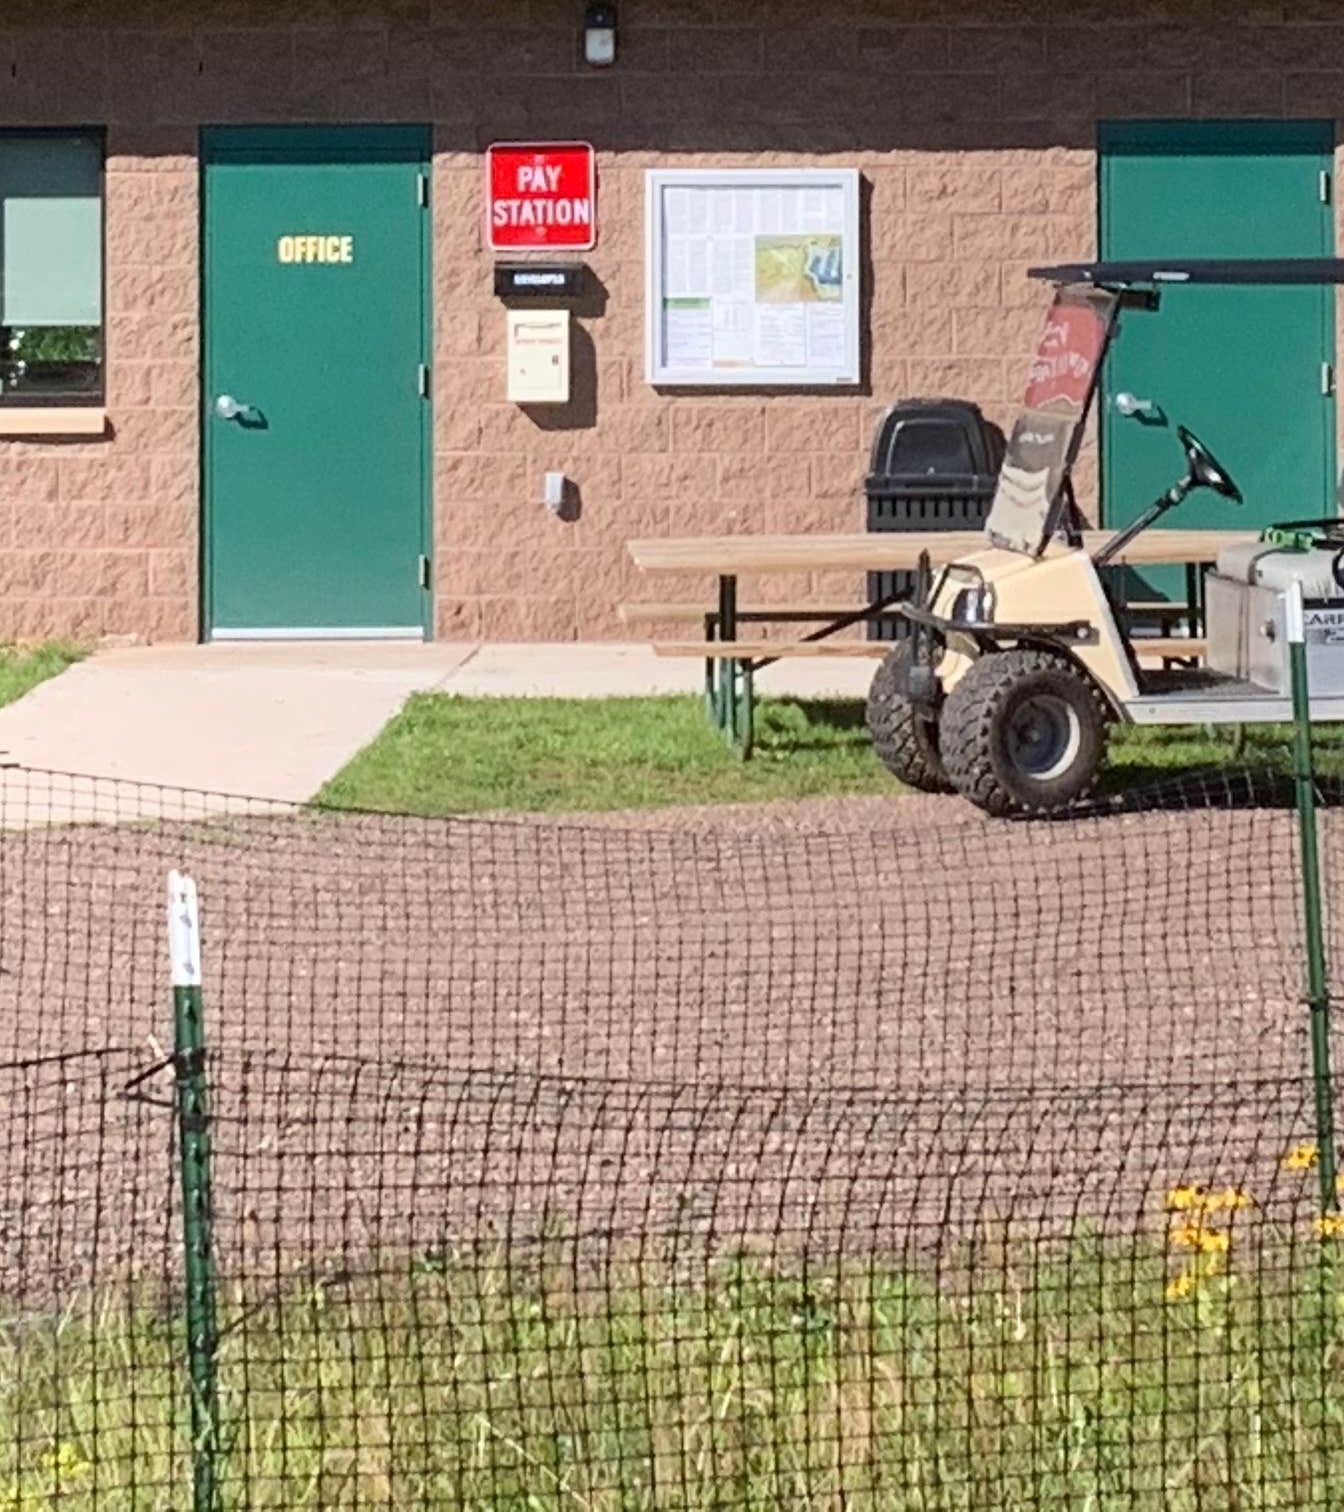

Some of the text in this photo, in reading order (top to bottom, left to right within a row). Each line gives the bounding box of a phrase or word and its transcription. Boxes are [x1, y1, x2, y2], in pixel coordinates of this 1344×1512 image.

[517, 165, 561, 192] PAY
[493, 198, 590, 226] STATION
[277, 235, 353, 263] OFFICE
